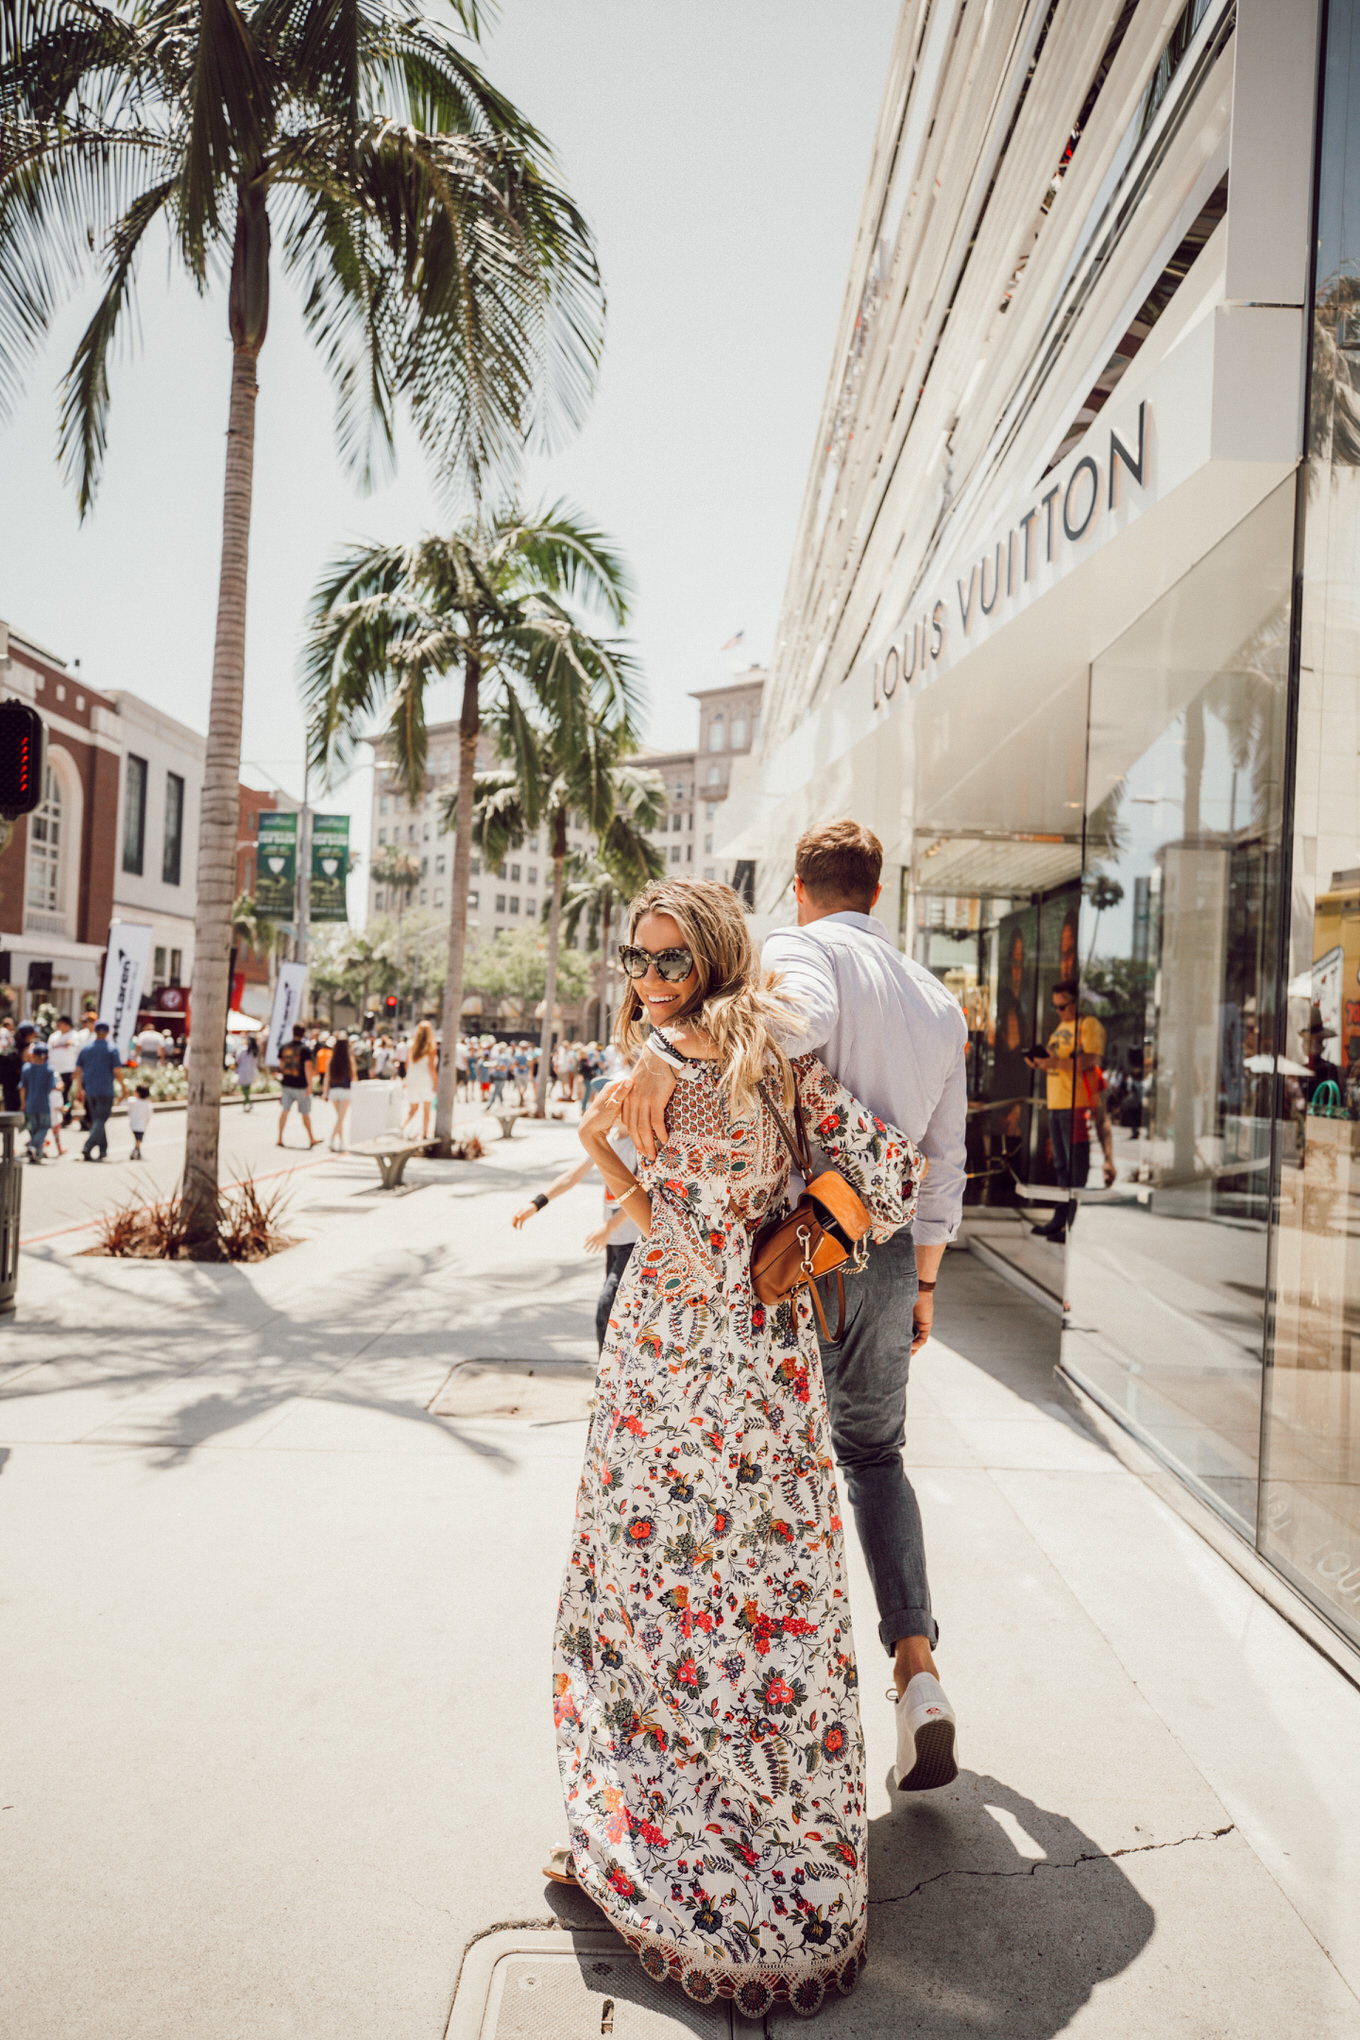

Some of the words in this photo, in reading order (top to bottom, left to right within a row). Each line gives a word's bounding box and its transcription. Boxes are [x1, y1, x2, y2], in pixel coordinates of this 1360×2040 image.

[873, 600, 945, 711] LOUIS
[957, 398, 1150, 637] VUITTON
[1303, 1540, 1360, 1604] LOU
